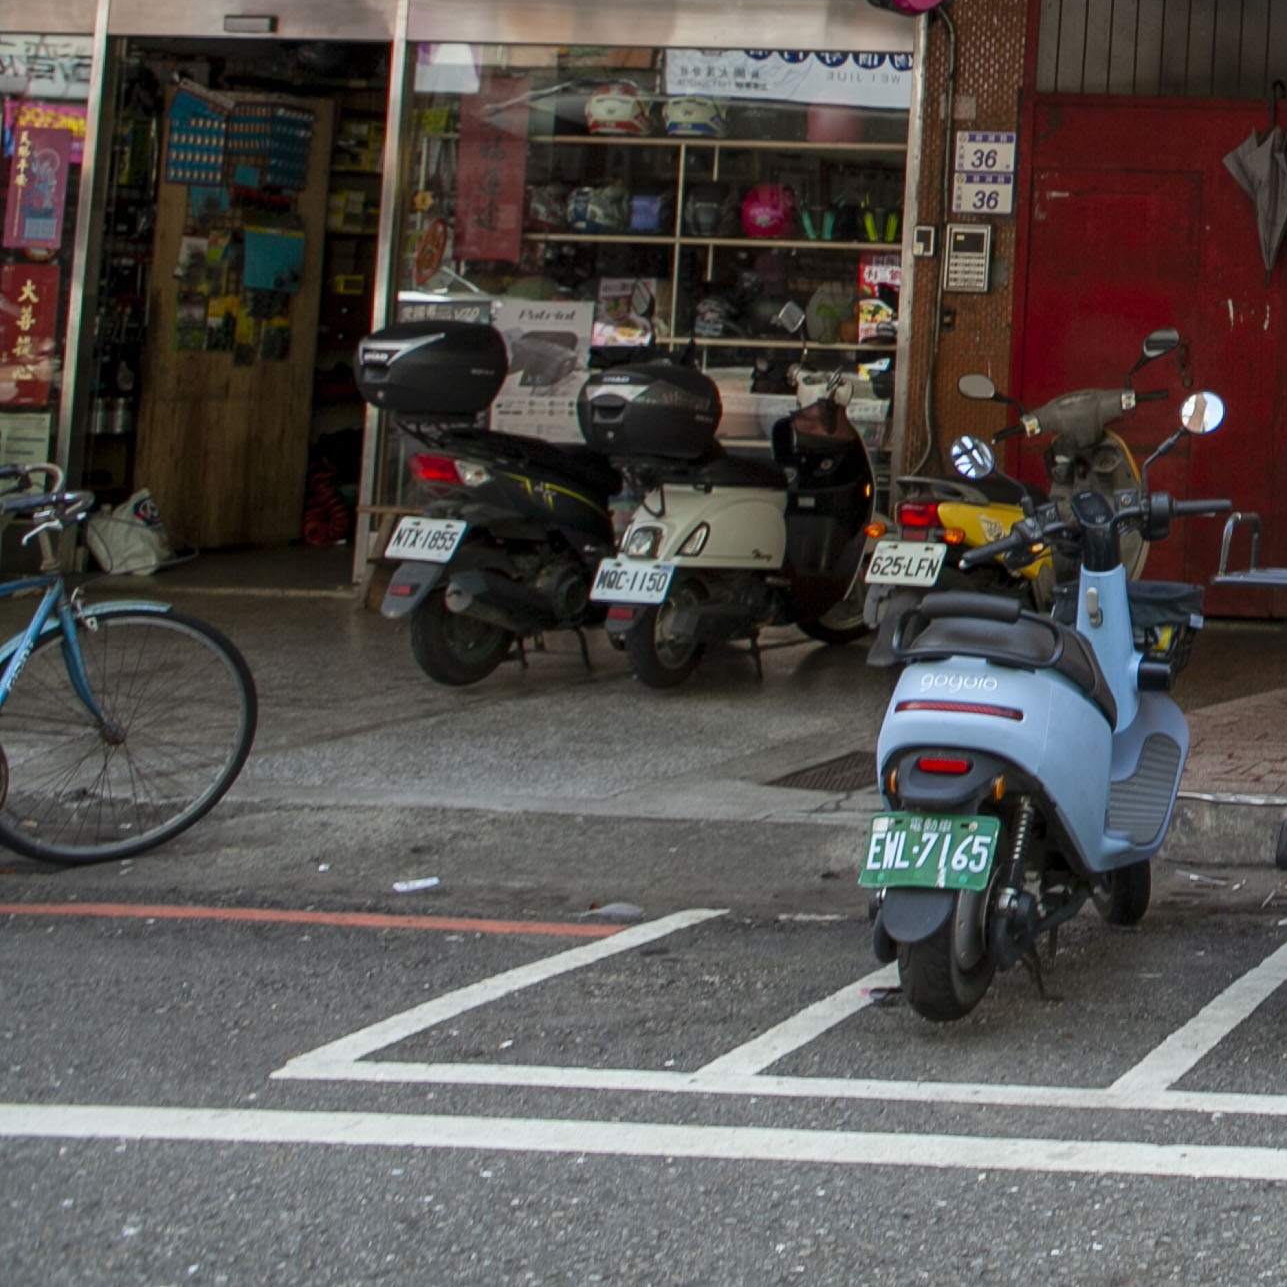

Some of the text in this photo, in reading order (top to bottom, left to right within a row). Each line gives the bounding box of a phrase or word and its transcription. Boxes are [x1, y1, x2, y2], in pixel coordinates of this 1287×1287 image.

[971, 149, 998, 169] 36
[972, 190, 1000, 210] 36
[869, 554, 939, 581] 625-LFN
[865, 831, 993, 875] EWL-7165
